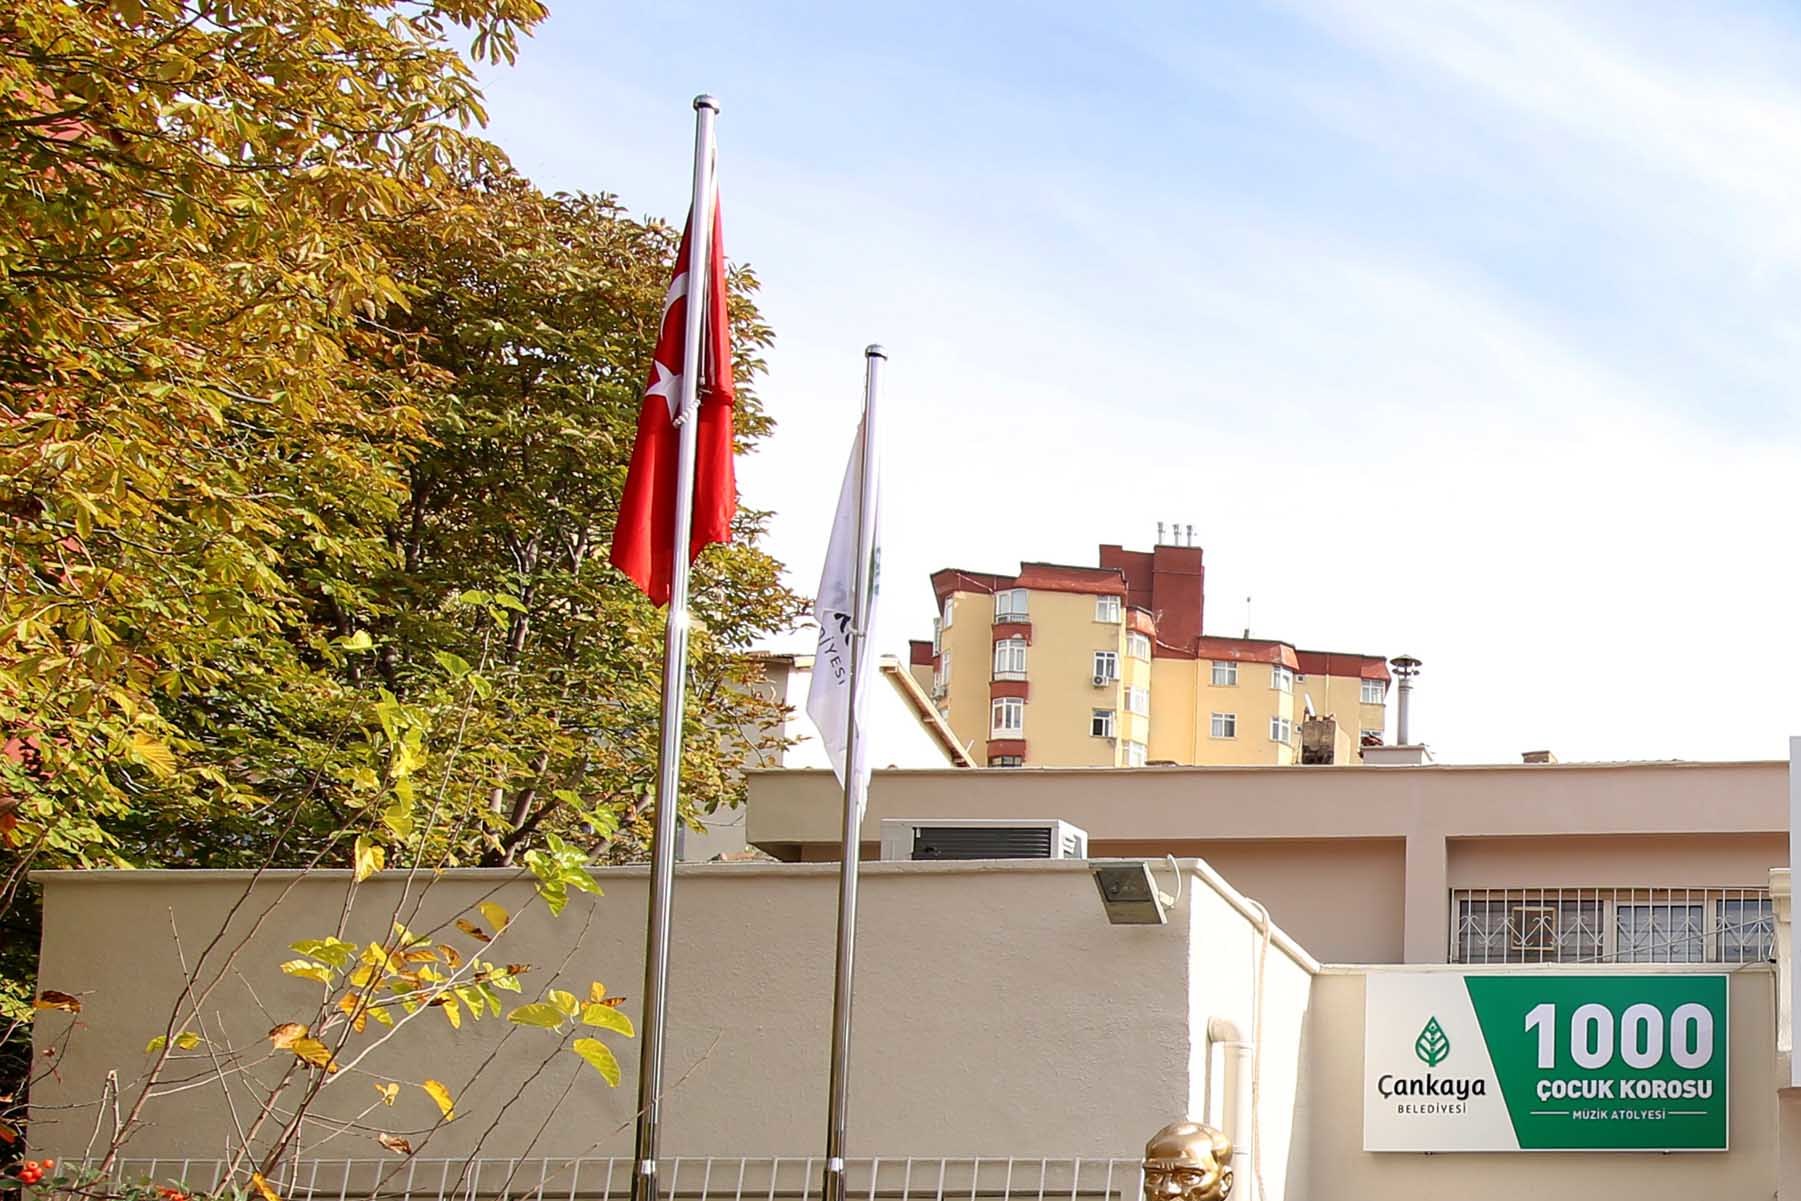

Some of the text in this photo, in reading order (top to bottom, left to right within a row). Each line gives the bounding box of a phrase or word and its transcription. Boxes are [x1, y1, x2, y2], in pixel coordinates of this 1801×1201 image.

[1524, 1002, 1715, 1071] 1000
[1377, 1072, 1487, 1101] Çankaya
[1536, 1079, 1714, 1103] ÇOCUK KOROSU
[1397, 1102, 1467, 1115] BELEDİYESİ
